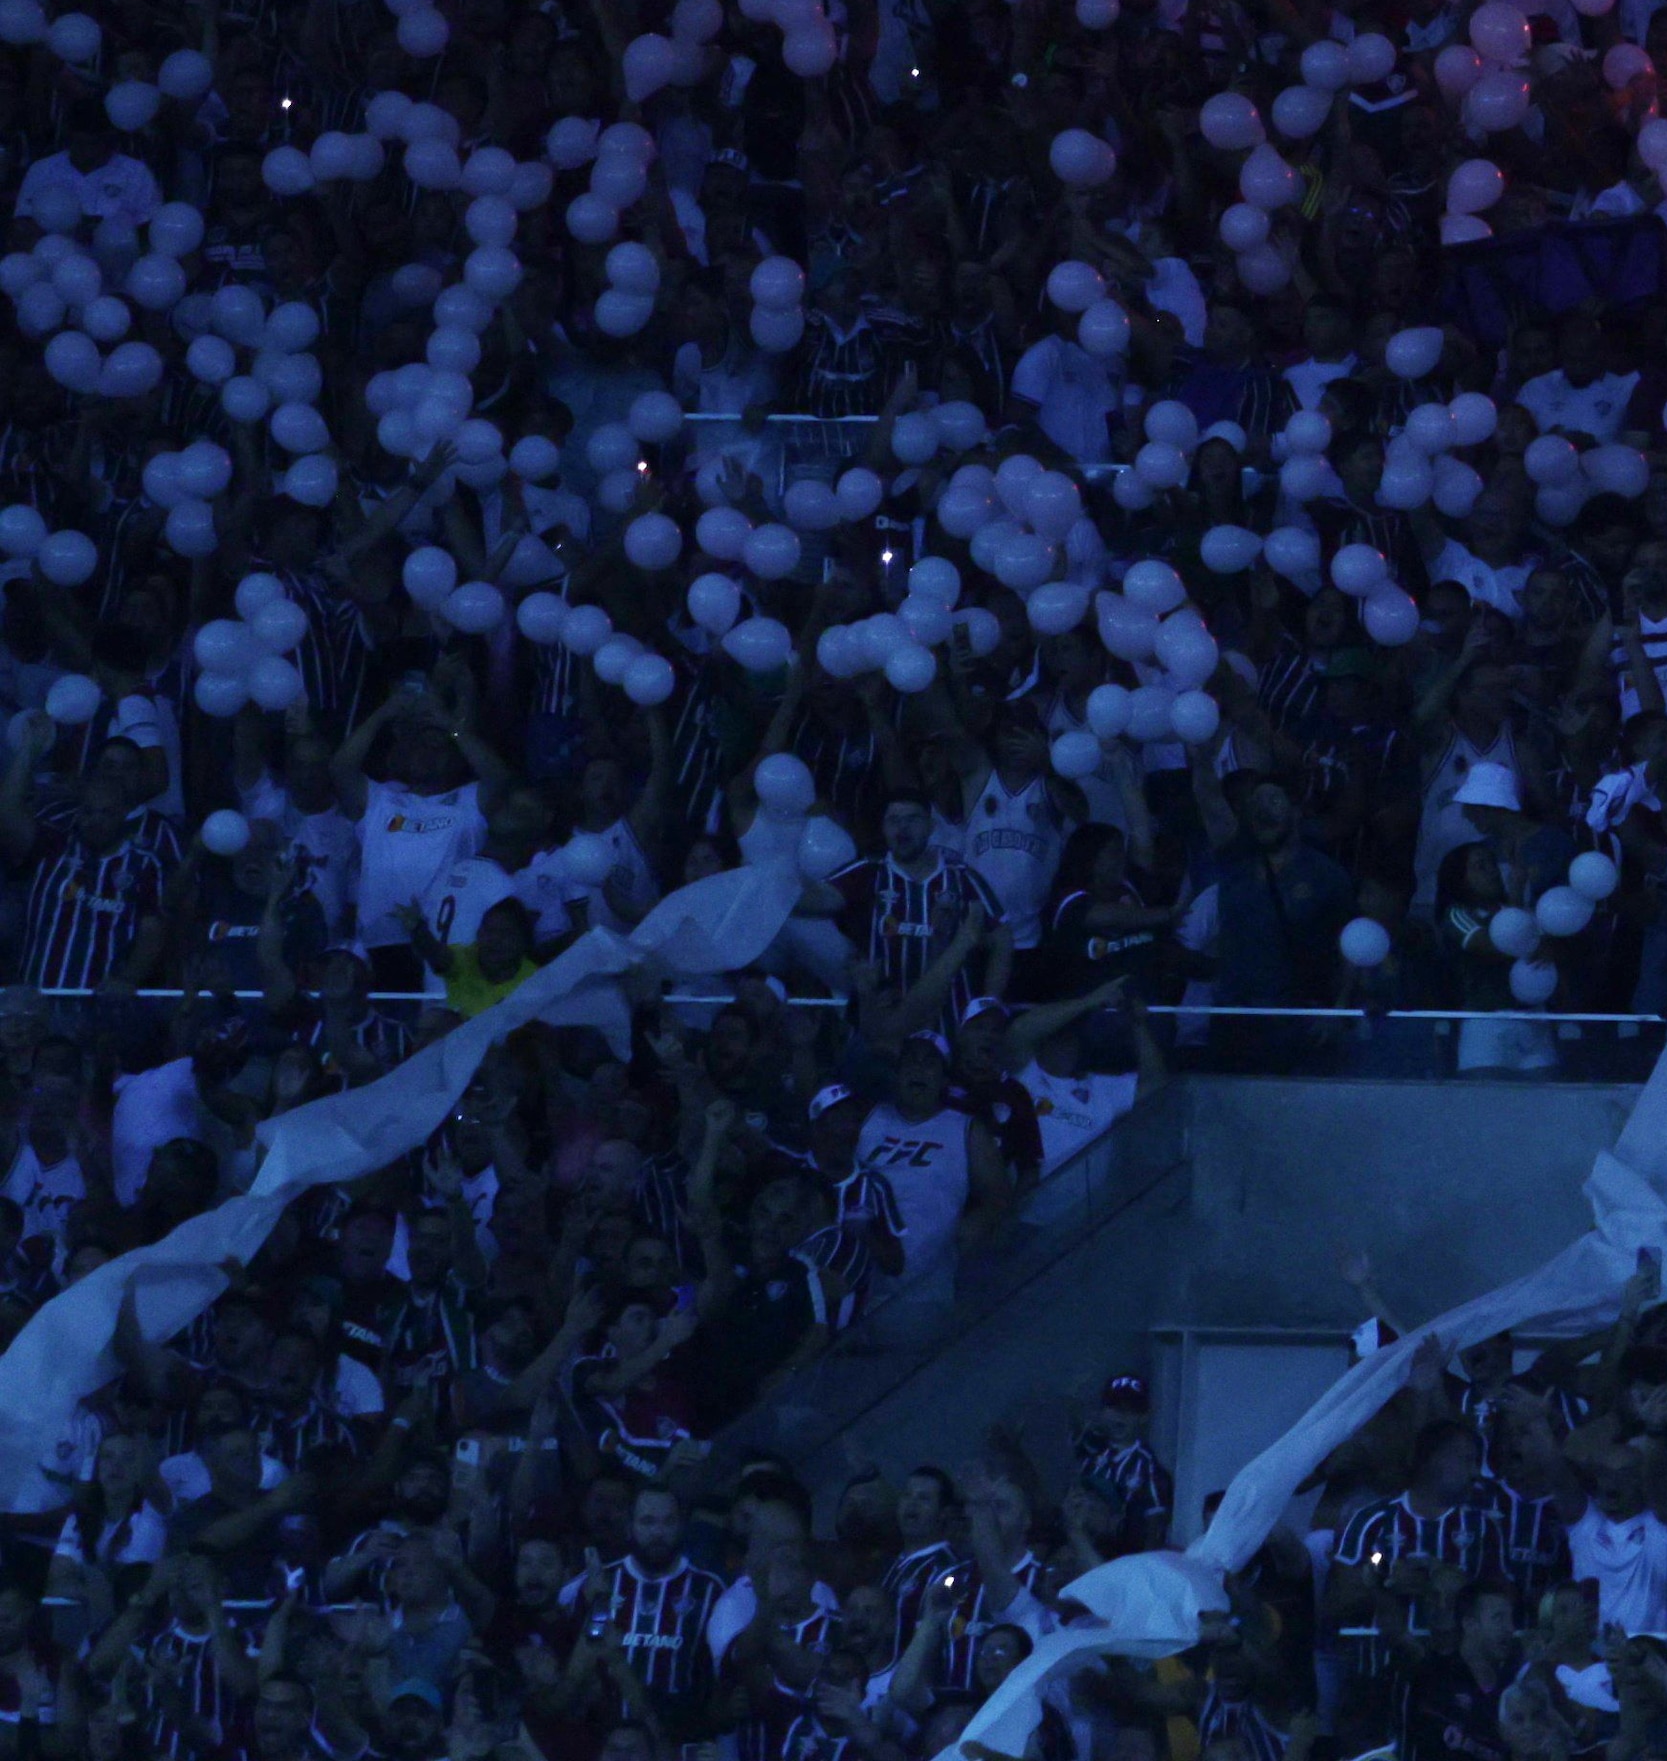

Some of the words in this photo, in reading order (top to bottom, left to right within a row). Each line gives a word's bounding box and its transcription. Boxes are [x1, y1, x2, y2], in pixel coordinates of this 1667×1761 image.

[867, 1135, 945, 1168] FFC
[1111, 1375, 1142, 1393] FFC
[622, 1631, 685, 1650] BETANO
